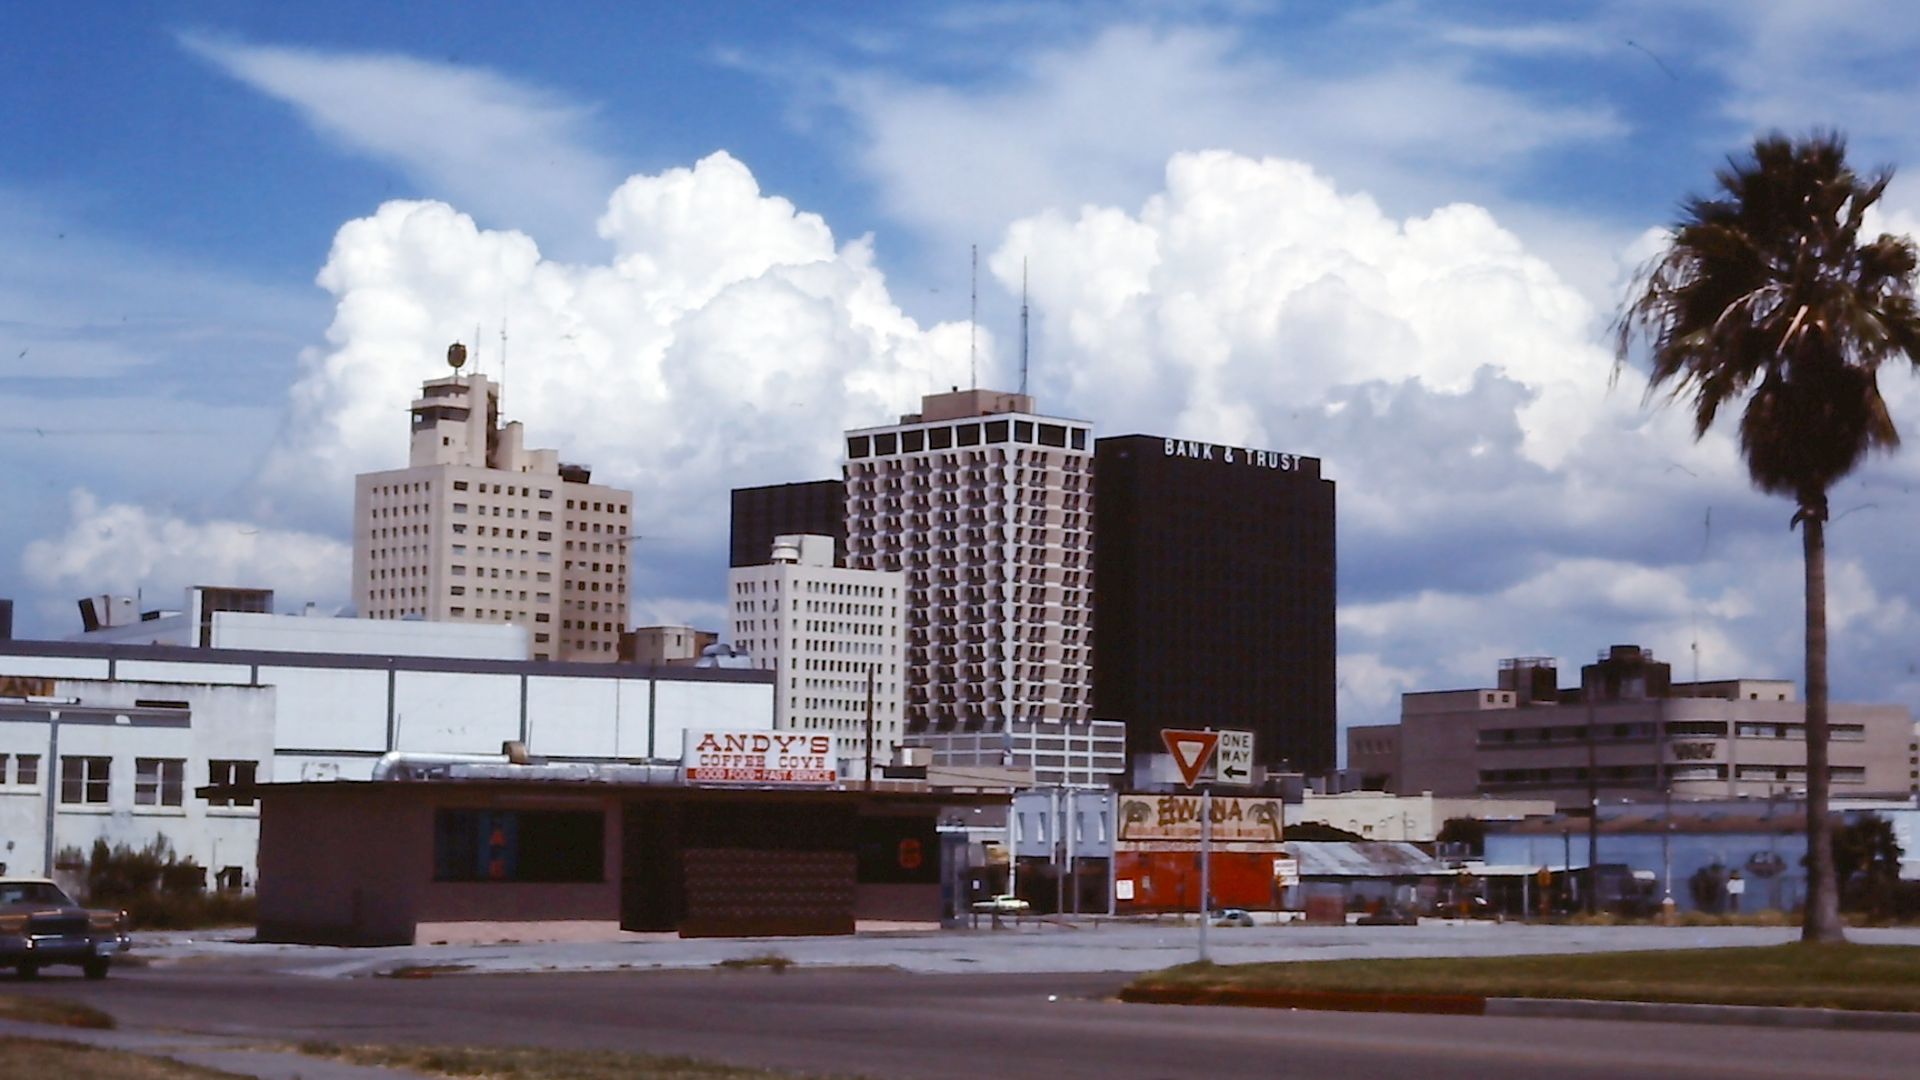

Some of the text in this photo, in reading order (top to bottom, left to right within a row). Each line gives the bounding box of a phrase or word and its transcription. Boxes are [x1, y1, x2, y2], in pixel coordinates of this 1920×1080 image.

[1164, 438, 1301, 471] BANK & TRUST
[696, 734, 830, 753] ANDY'S
[1222, 734, 1249, 749] ONE
[700, 754, 825, 768] COFFEE COVE
[1221, 751, 1249, 763] WAY
[696, 768, 725, 780] GOOD
